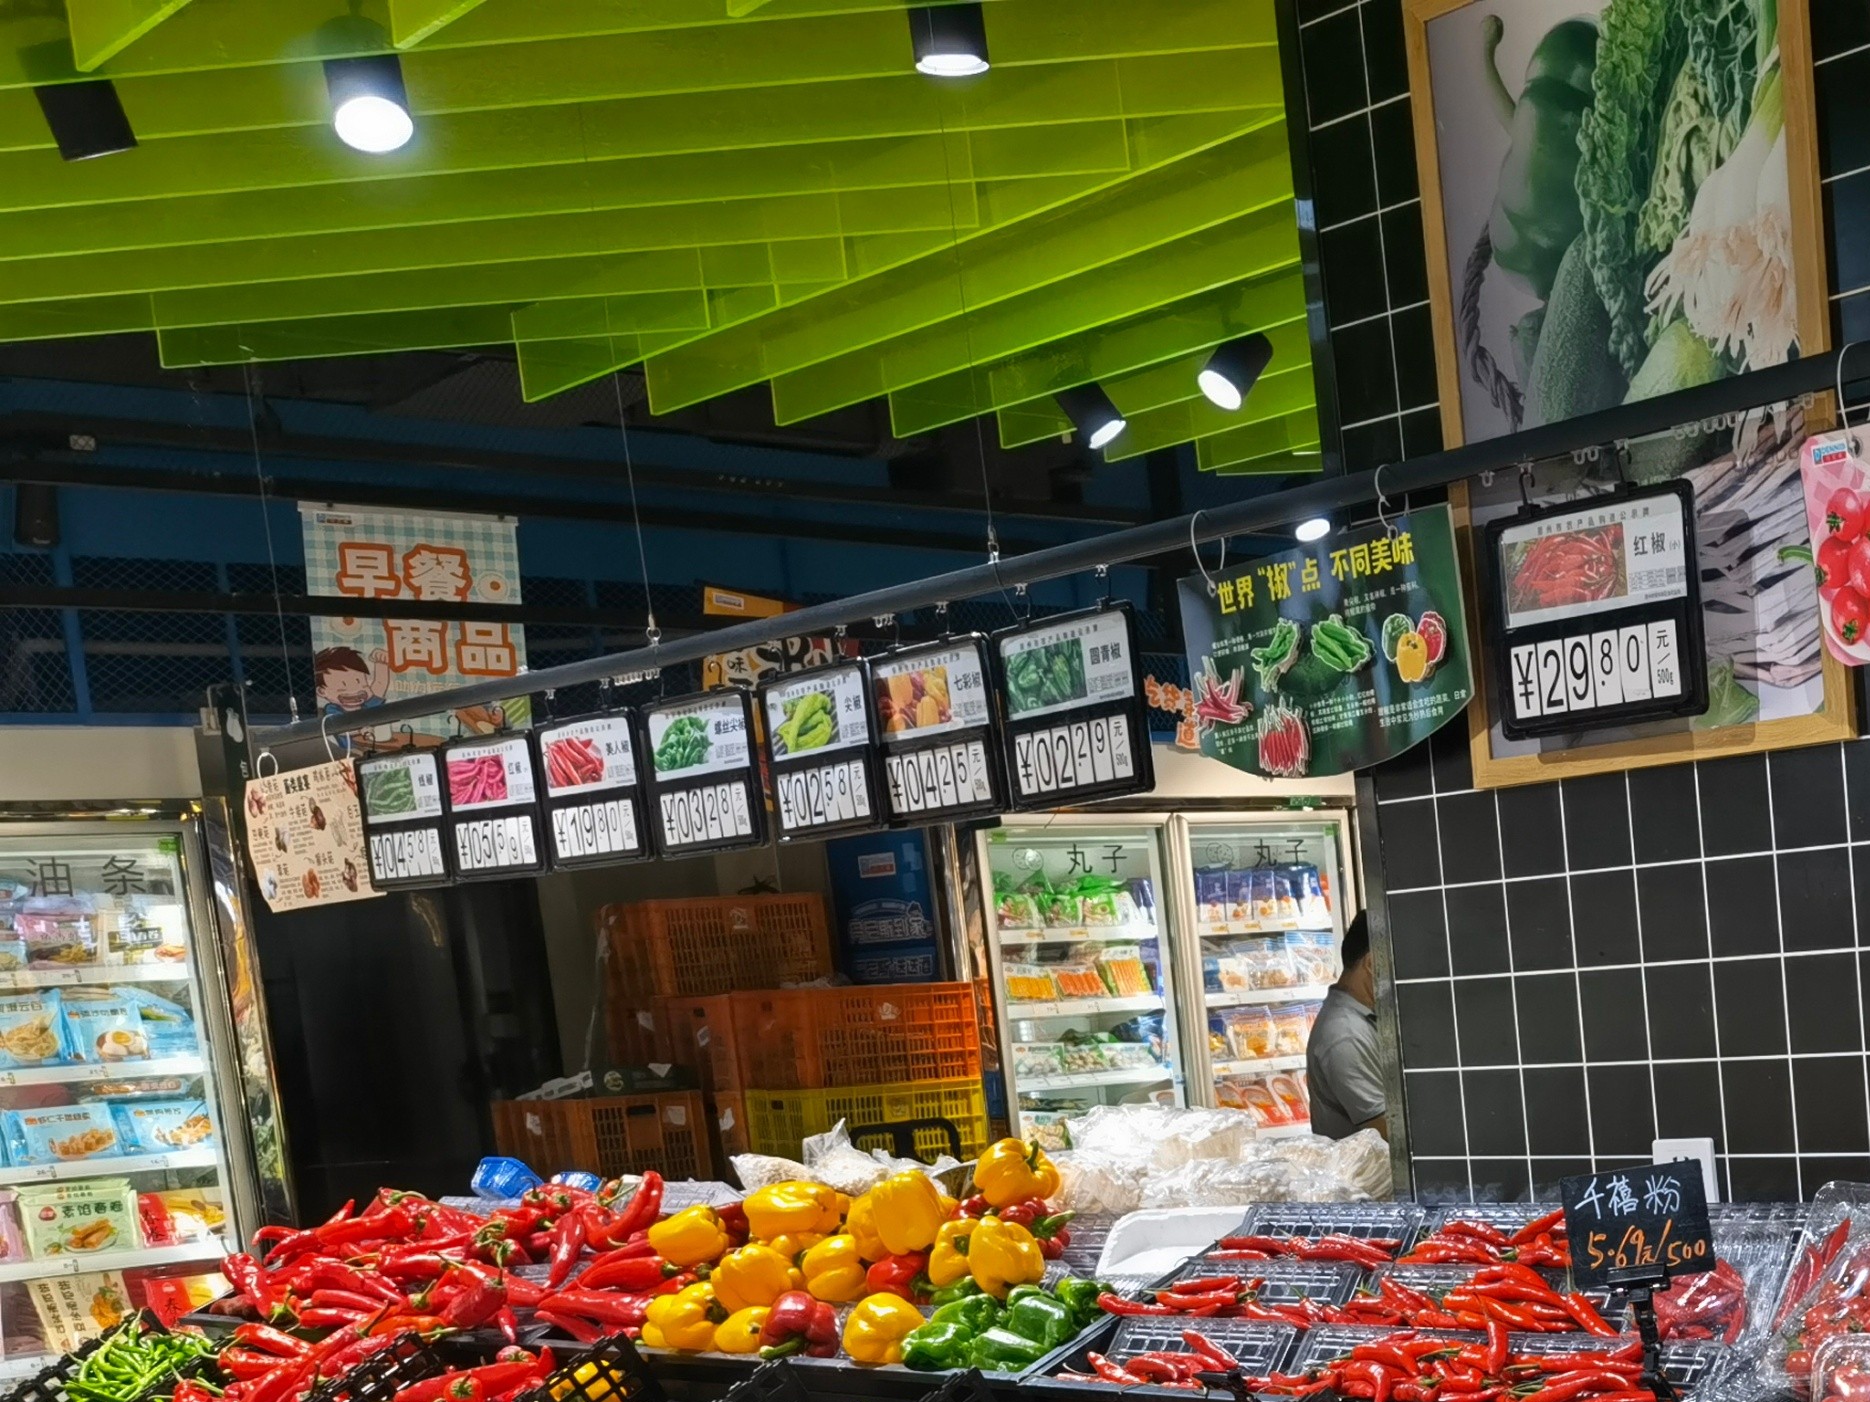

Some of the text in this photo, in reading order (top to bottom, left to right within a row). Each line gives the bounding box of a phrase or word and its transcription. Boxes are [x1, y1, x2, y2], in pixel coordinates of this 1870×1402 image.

[1633, 532, 1666, 556] 红椒
[338, 543, 473, 600] 早餐
[385, 619, 517, 677] 商品
[1068, 843, 1127, 875] 丸子
[1253, 838, 1308, 869] 丸子
[26, 855, 146, 897] 油条
